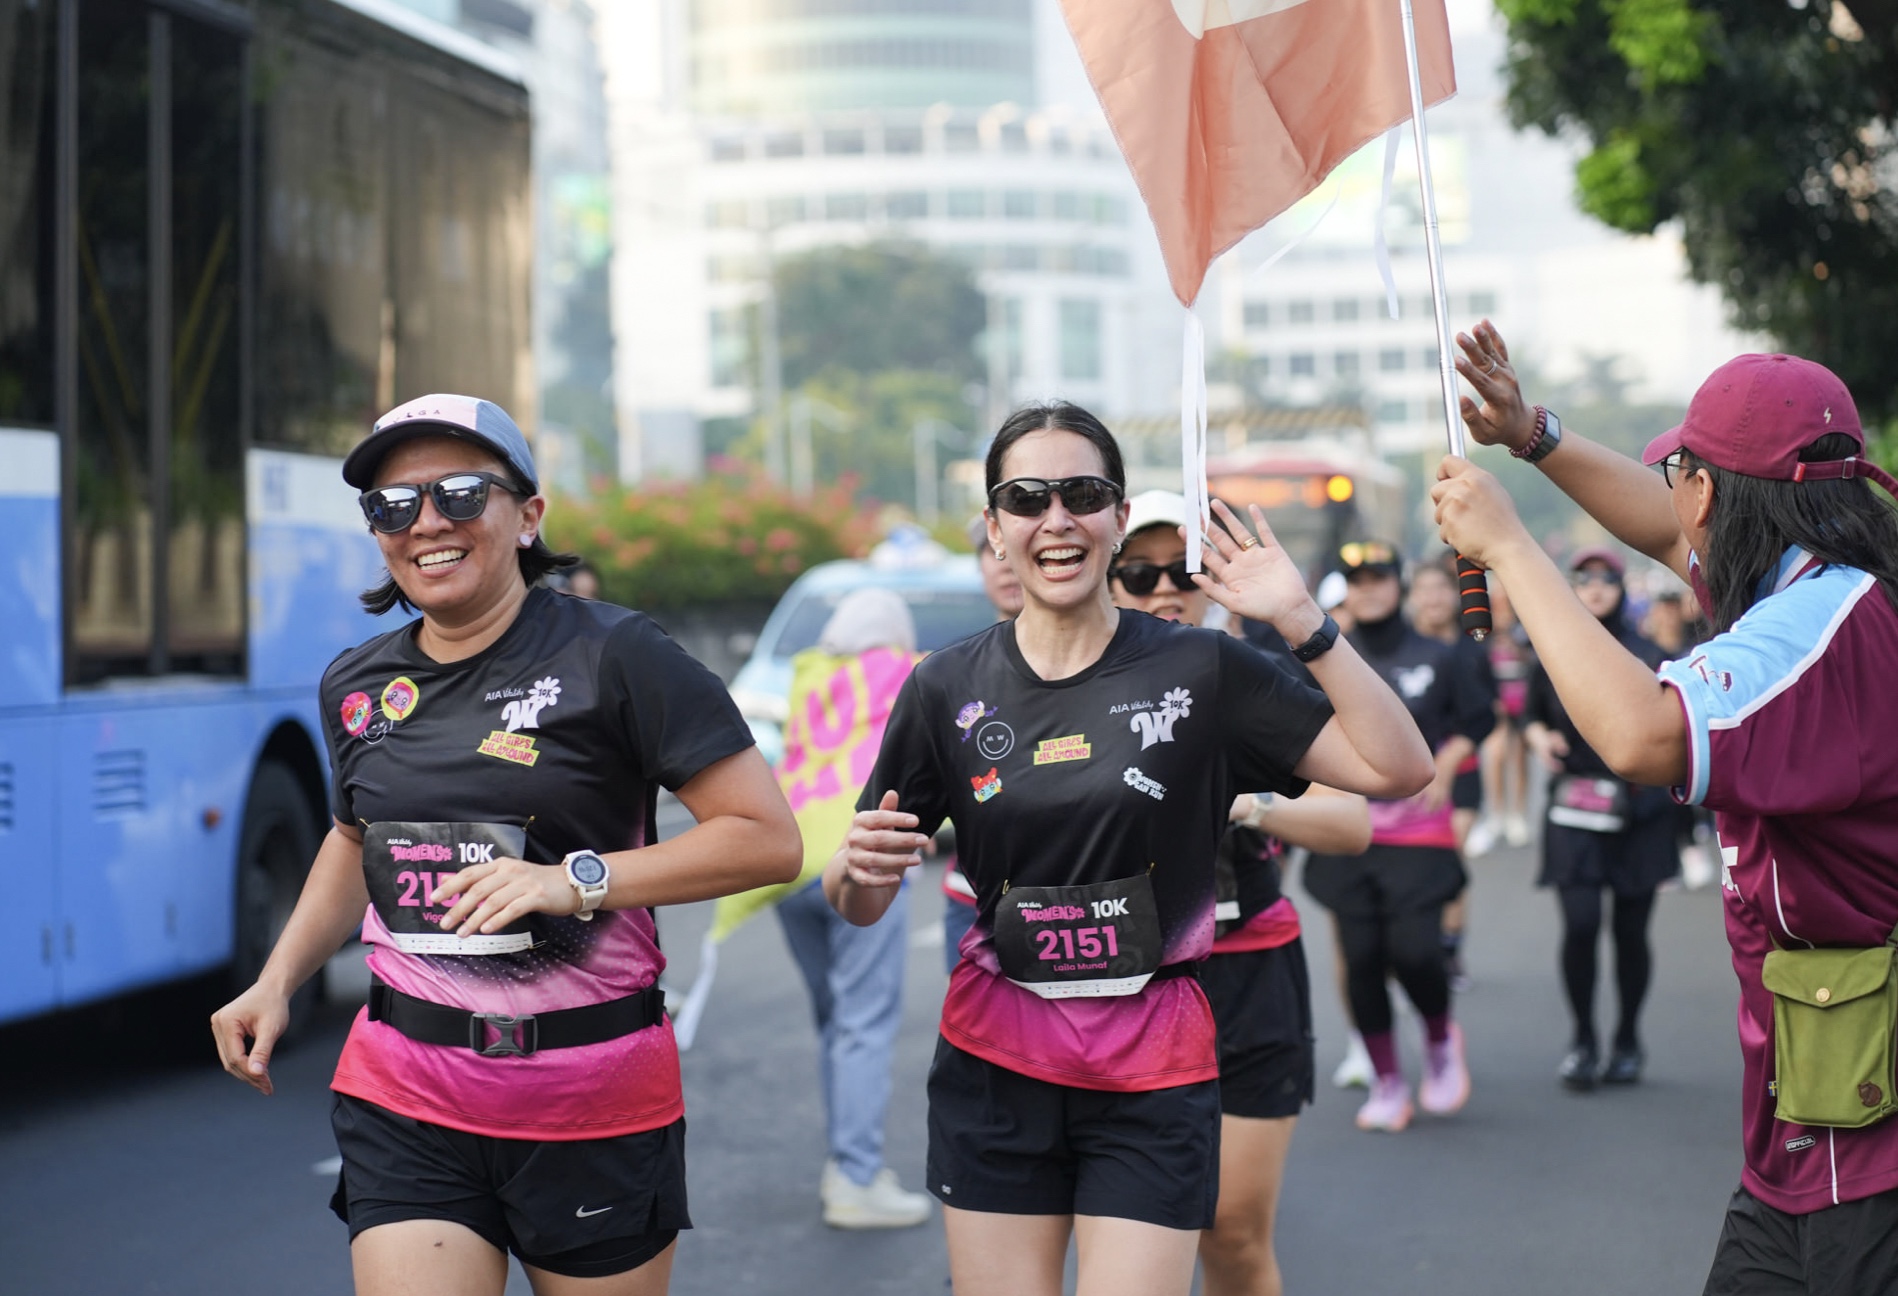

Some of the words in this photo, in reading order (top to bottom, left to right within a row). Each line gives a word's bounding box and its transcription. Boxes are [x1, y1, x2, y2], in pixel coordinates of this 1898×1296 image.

[485, 691, 503, 702] AIA
[1109, 703, 1130, 714] AIA
[458, 842, 495, 863] 10K
[396, 870, 485, 907] 215
[1091, 897, 1129, 918] 10K
[1036, 925, 1119, 960] 2151
[1053, 963, 1076, 972] Laila
[1077, 961, 1108, 970] Munaf
